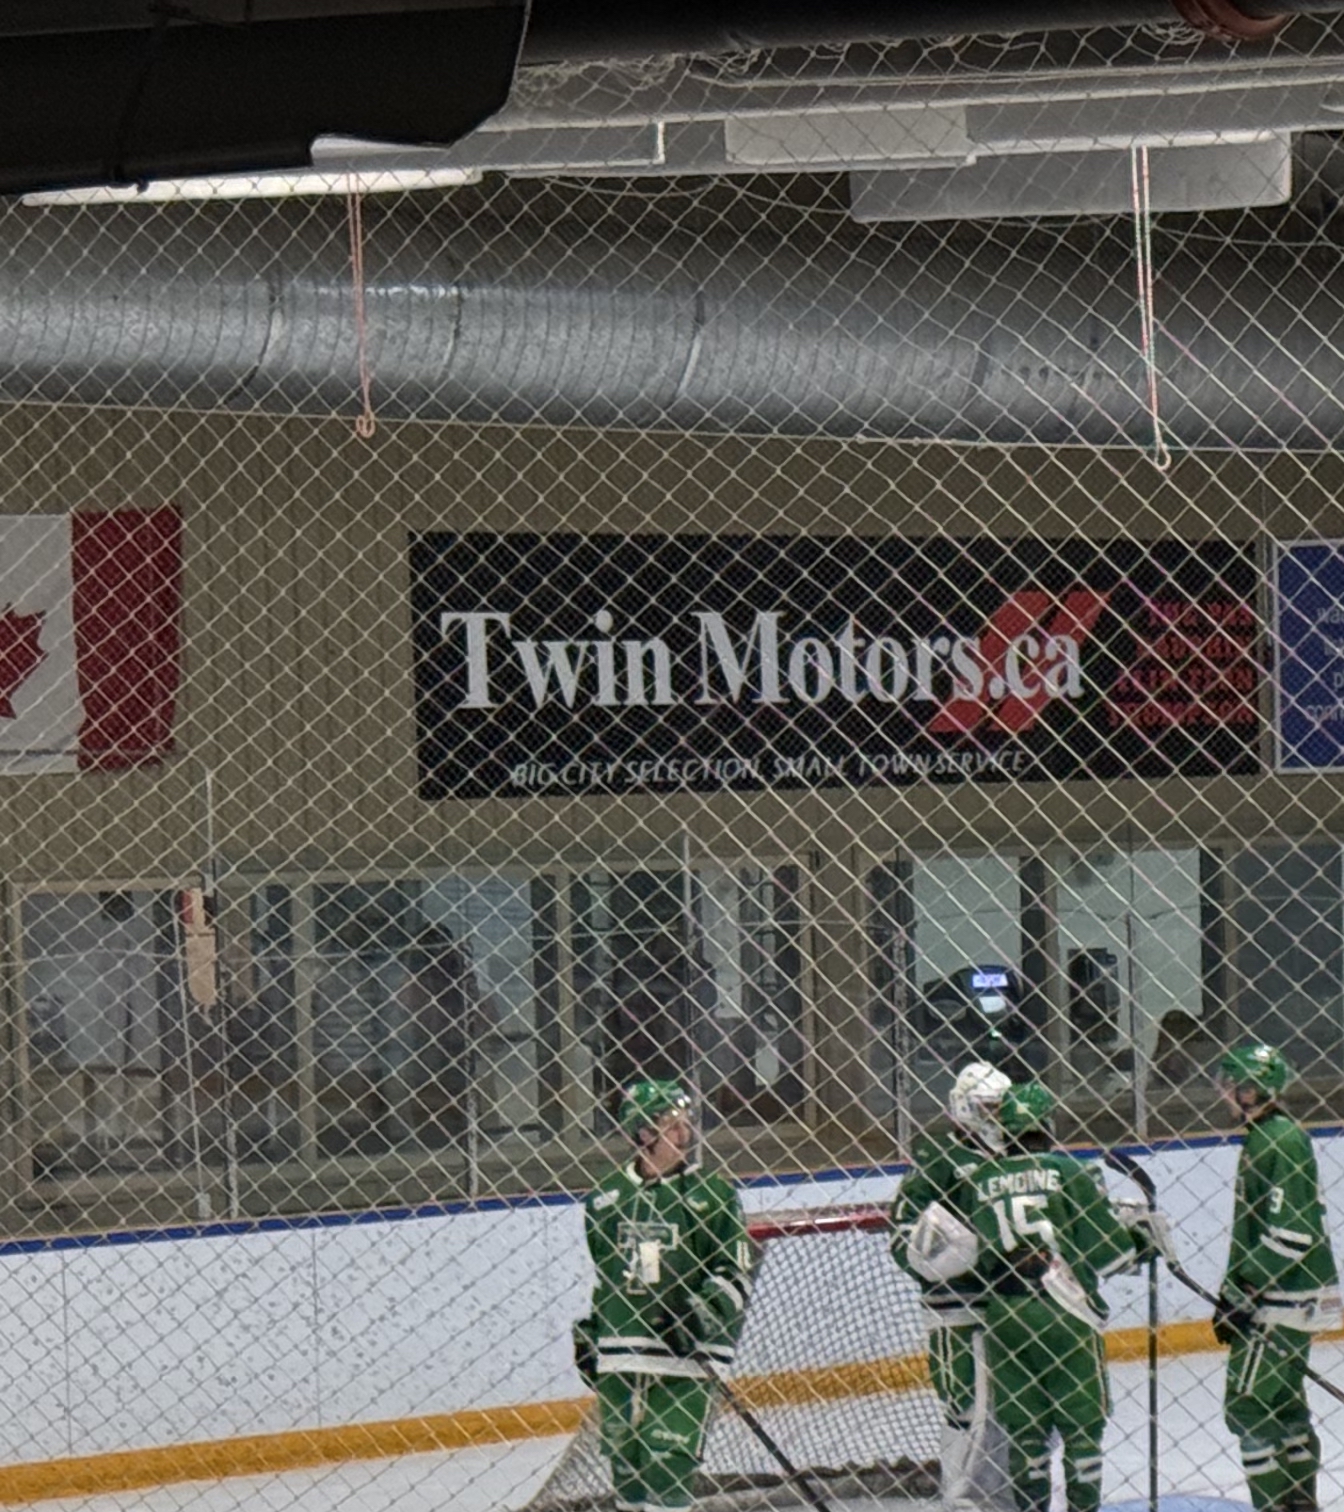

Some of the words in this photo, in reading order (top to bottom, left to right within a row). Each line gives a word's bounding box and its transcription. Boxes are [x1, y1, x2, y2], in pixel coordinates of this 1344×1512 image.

[441, 609, 679, 710] Twin
[694, 608, 1087, 706] Motors.ca
[512, 763, 551, 788] BIG
[772, 754, 849, 779] SMALL
